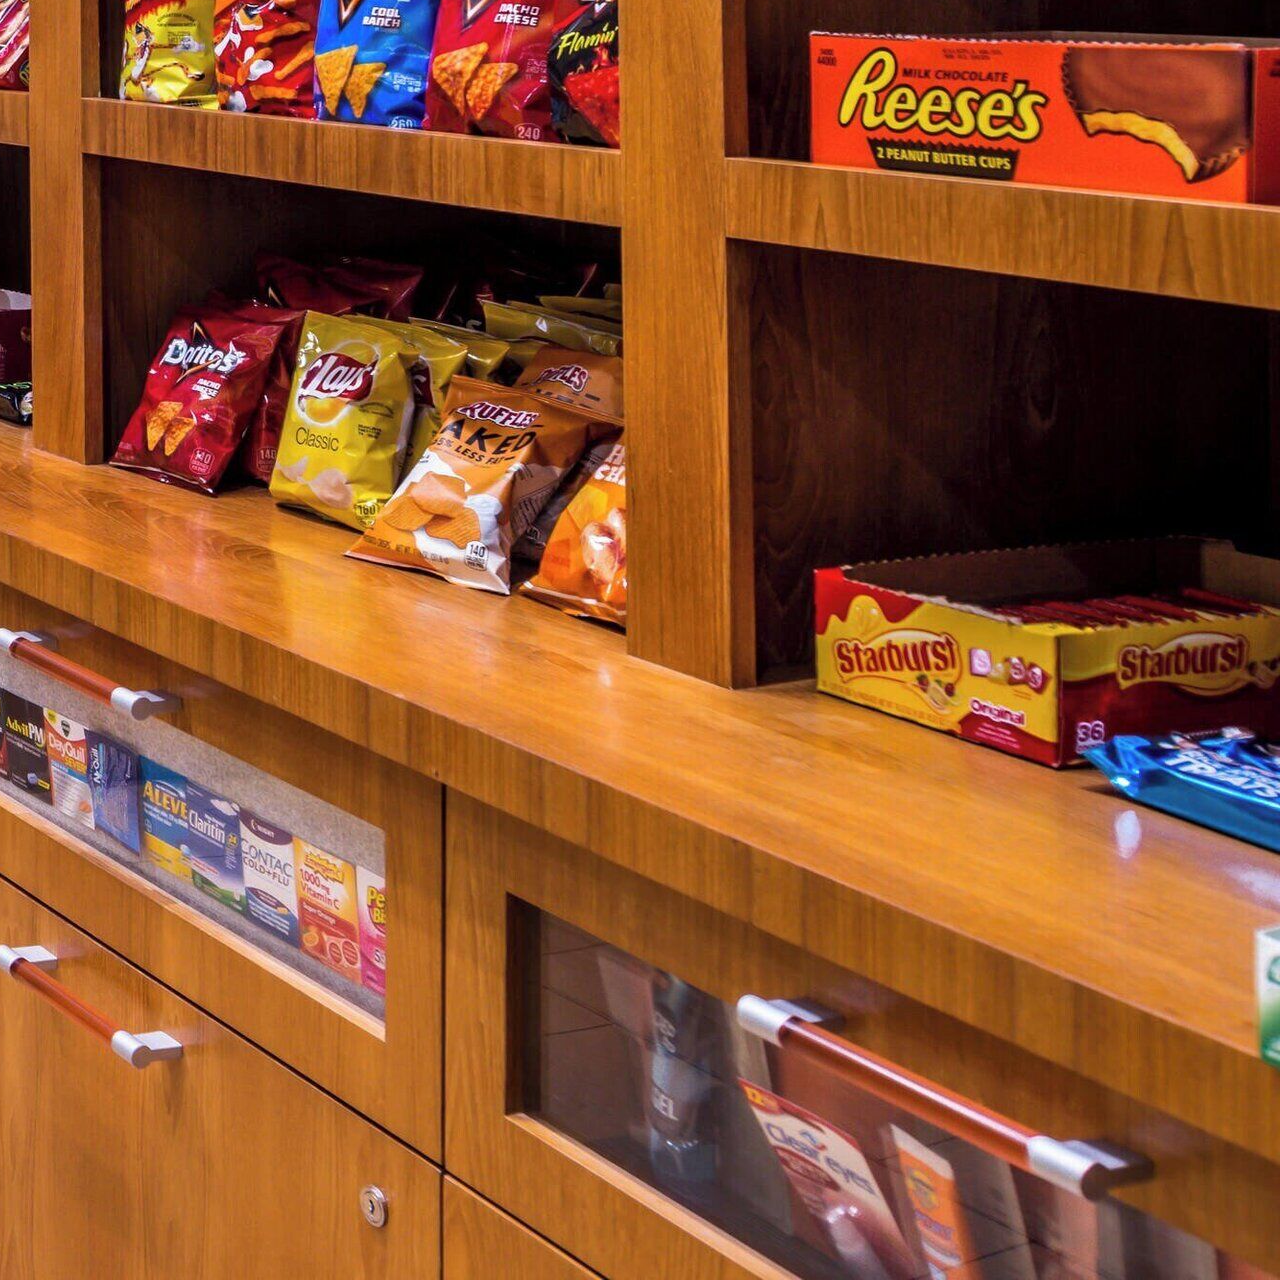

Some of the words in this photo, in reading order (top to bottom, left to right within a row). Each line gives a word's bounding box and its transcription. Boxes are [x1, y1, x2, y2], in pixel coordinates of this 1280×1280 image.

[362, 16, 401, 28] RANCH
[371, 6, 401, 18] COOL
[494, 14, 539, 27] CHEESE
[500, 3, 540, 16] NACHO
[556, 25, 618, 60] Flamin'
[902, 67, 931, 80] MILK
[934, 69, 1010, 83] CHOCOLATE
[838, 46, 1049, 142] Reese's
[517, 126, 540, 141] 240
[876, 146, 885, 159] 2
[885, 147, 931, 163] PEANUT
[932, 151, 977, 167] BUTTER
[979, 155, 1012, 170] CUPS
[163, 338, 245, 372] Doritos
[197, 378, 222, 390] NACHO
[298, 354, 374, 400] Lay's
[458, 402, 538, 428] RUFFLES
[295, 426, 340, 453] Classic
[440, 419, 537, 456] AKED
[454, 445, 485, 463] LESS
[355, 504, 377, 517] 160
[468, 542, 486, 558] 140
[836, 634, 958, 674] Starburst
[1120, 634, 1245, 682] Starburst
[971, 699, 1026, 726] Original
[5, 715, 30, 737] Advil
[29, 723, 45, 745] PM
[1077, 720, 1105, 742] 36
[48, 733, 86, 764] DayQuil
[142, 779, 188, 820] ALEVE
[189, 809, 226, 845] Claritin
[241, 838, 293, 879] CONTAC
[241, 856, 290, 888] COLD+FLU
[299, 867, 321, 887] 1000
[300, 883, 333, 907] Vitamin
[332, 897, 341, 910] C
[317, 908, 337, 926] Orange
[765, 1122, 821, 1162] Clear
[825, 1155, 879, 1198] eyes
